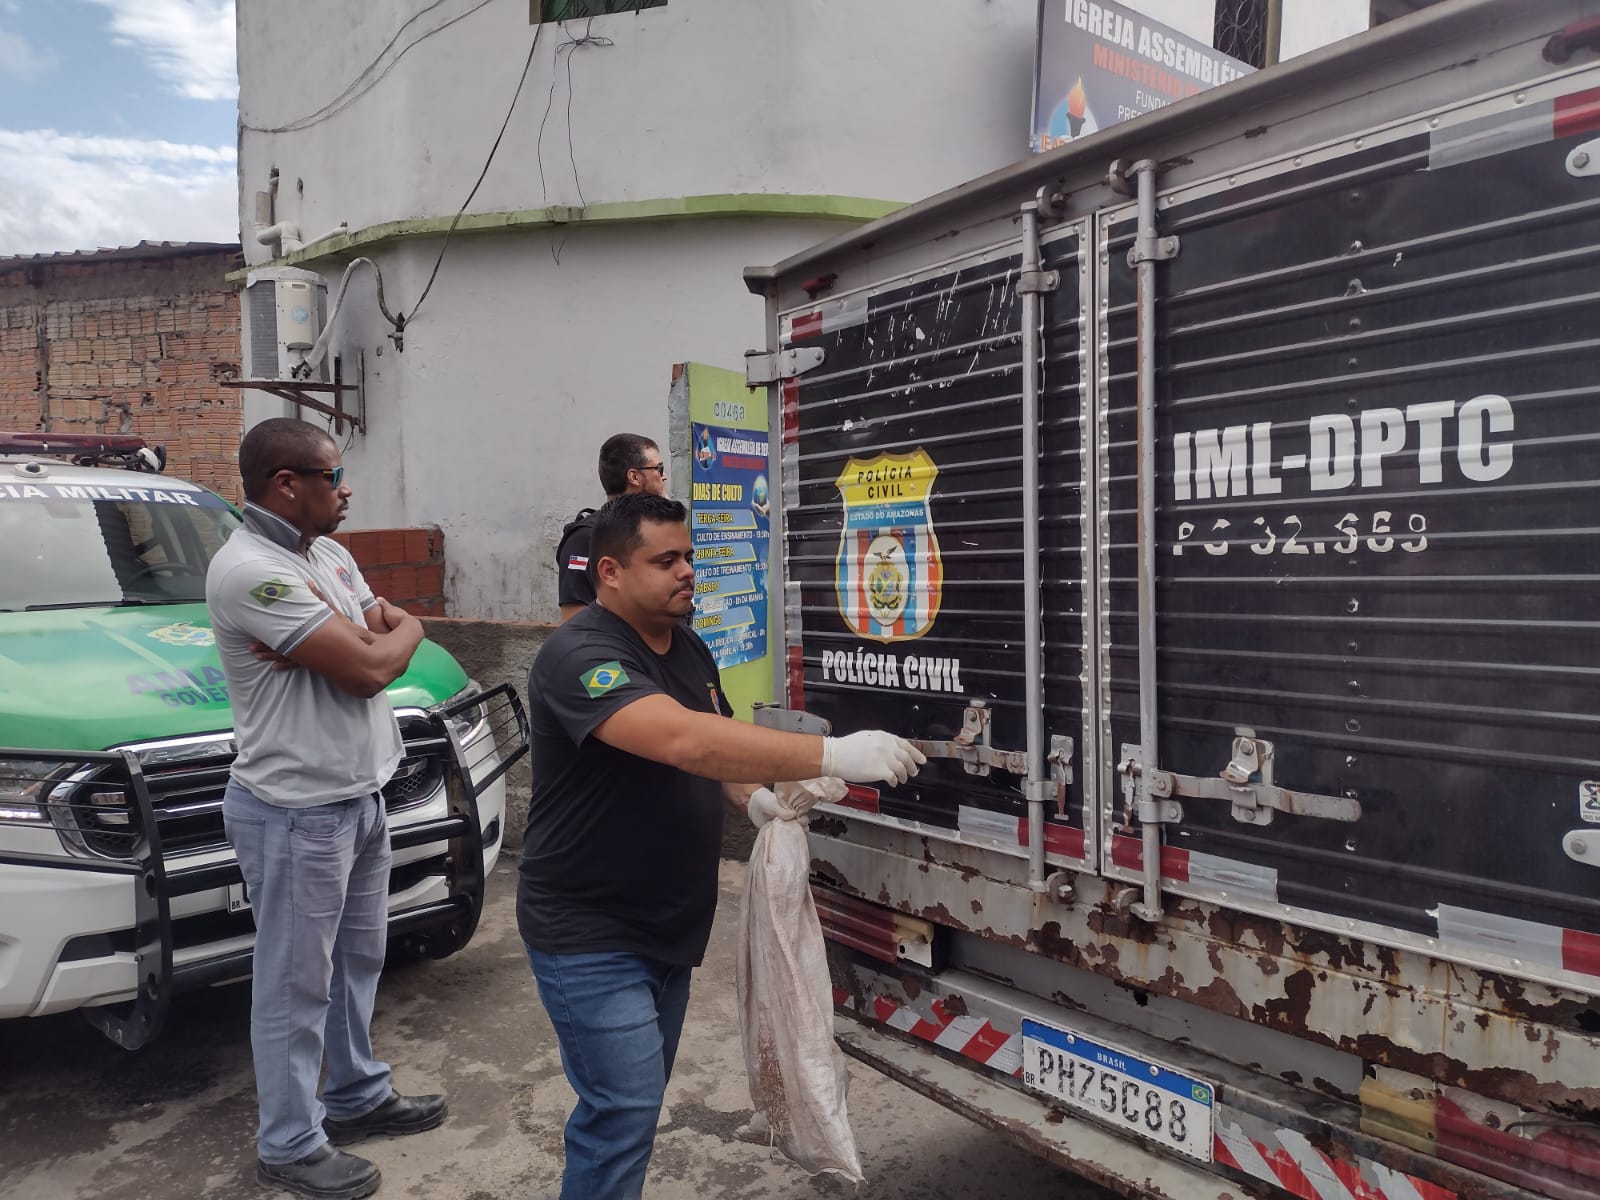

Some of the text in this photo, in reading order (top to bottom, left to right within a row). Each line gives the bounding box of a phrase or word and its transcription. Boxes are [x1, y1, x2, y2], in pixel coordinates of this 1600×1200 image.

[1065, 0, 1134, 50] IGREJA
[1173, 394, 1514, 500] IML-DPTC
[857, 465, 912, 484] POLÍCIA
[55, 486, 199, 506] MILITAR
[693, 483, 742, 502] DIAS DE CULTO
[868, 484, 903, 499] CIVIL
[850, 509, 924, 521] ESTADO DO AMAZONAS
[697, 532, 712, 542] CULTO
[713, 532, 720, 540] DE
[696, 547, 734, 560] QUINTA-FEIRA
[696, 569, 712, 578] CULTO
[713, 567, 719, 576] DE
[696, 580, 720, 594] SÁBADO
[822, 646, 964, 692] POLÍCIA CIVIL
[1097, 1052, 1126, 1071] BRASIL
[1025, 1071, 1035, 1084] BR
[1038, 1046, 1187, 1142] PHZ5C88
